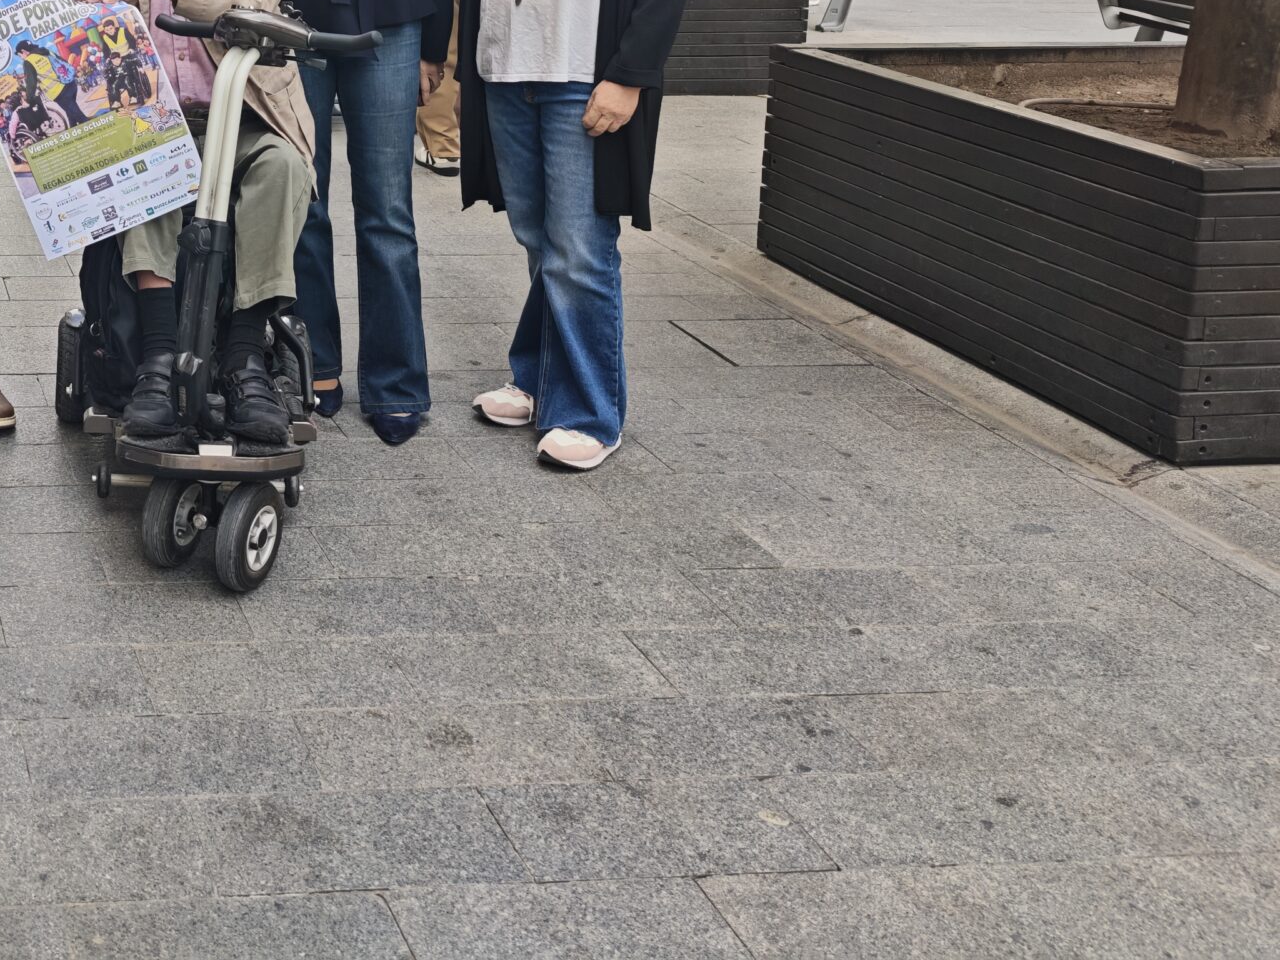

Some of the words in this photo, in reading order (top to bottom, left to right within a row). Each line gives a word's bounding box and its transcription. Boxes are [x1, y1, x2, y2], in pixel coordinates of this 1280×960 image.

[30, 18, 60, 38] PARA
[28, 138, 58, 154] Viernes
[60, 133, 70, 142] 30
[71, 128, 81, 136] de
[83, 114, 114, 132] octubre
[43, 172, 75, 190] REGALOS
[76, 165, 94, 178] PARA
